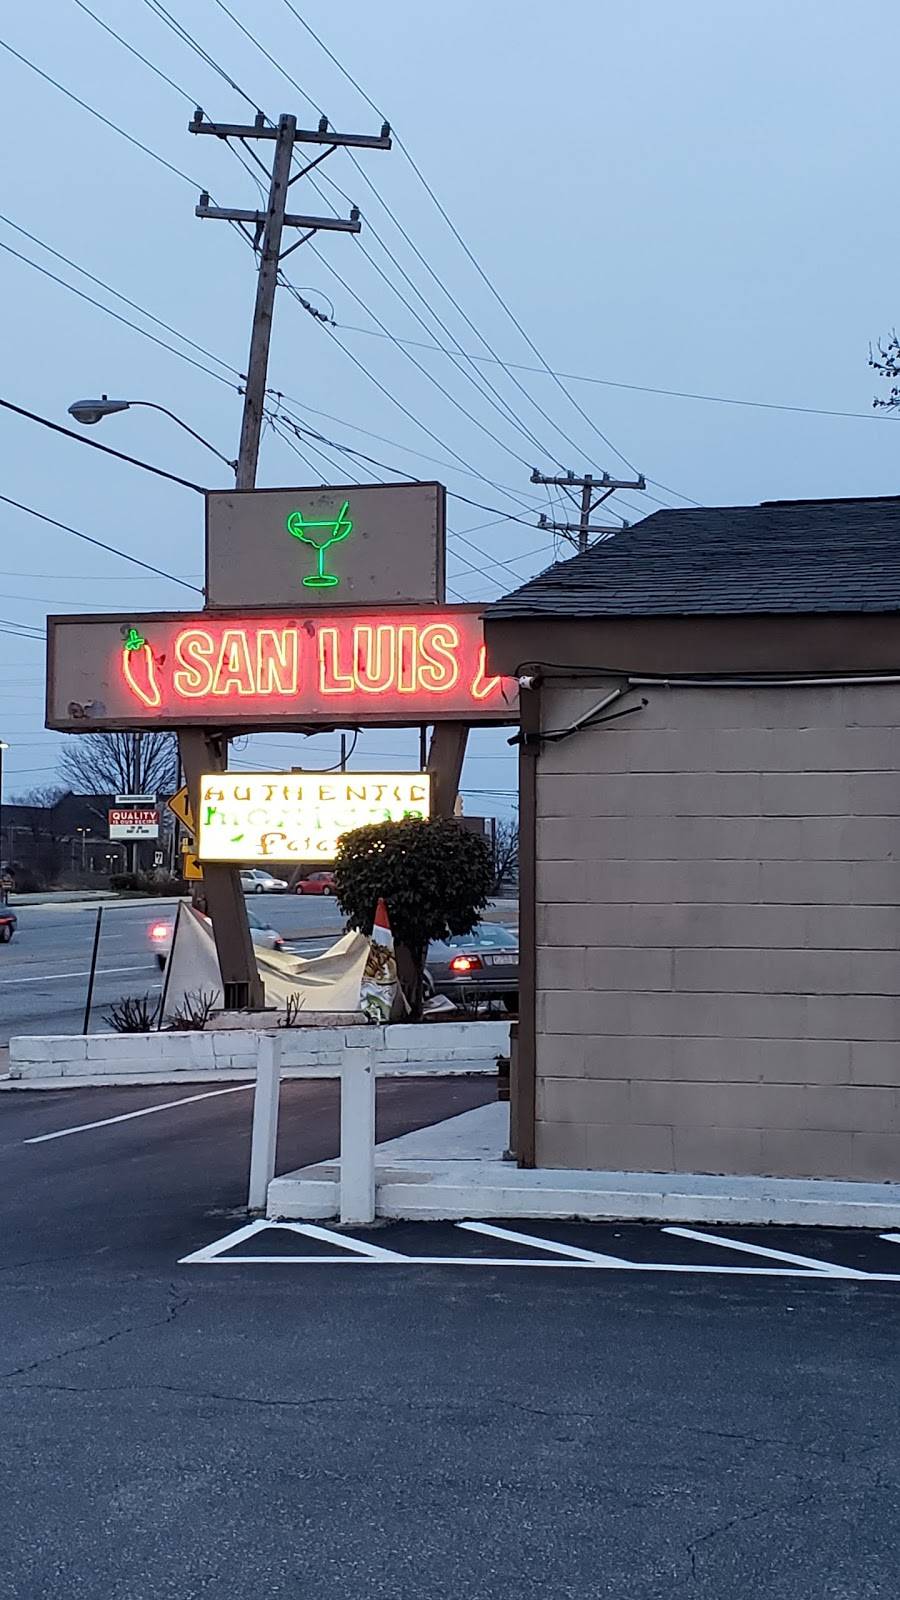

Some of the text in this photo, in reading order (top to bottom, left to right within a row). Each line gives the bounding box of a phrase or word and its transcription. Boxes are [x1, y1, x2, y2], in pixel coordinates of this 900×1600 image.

[174, 623, 460, 697] SAN LUIS
[204, 784, 426, 801] AUTHENTIC
[112, 811, 157, 820] QUALITY
